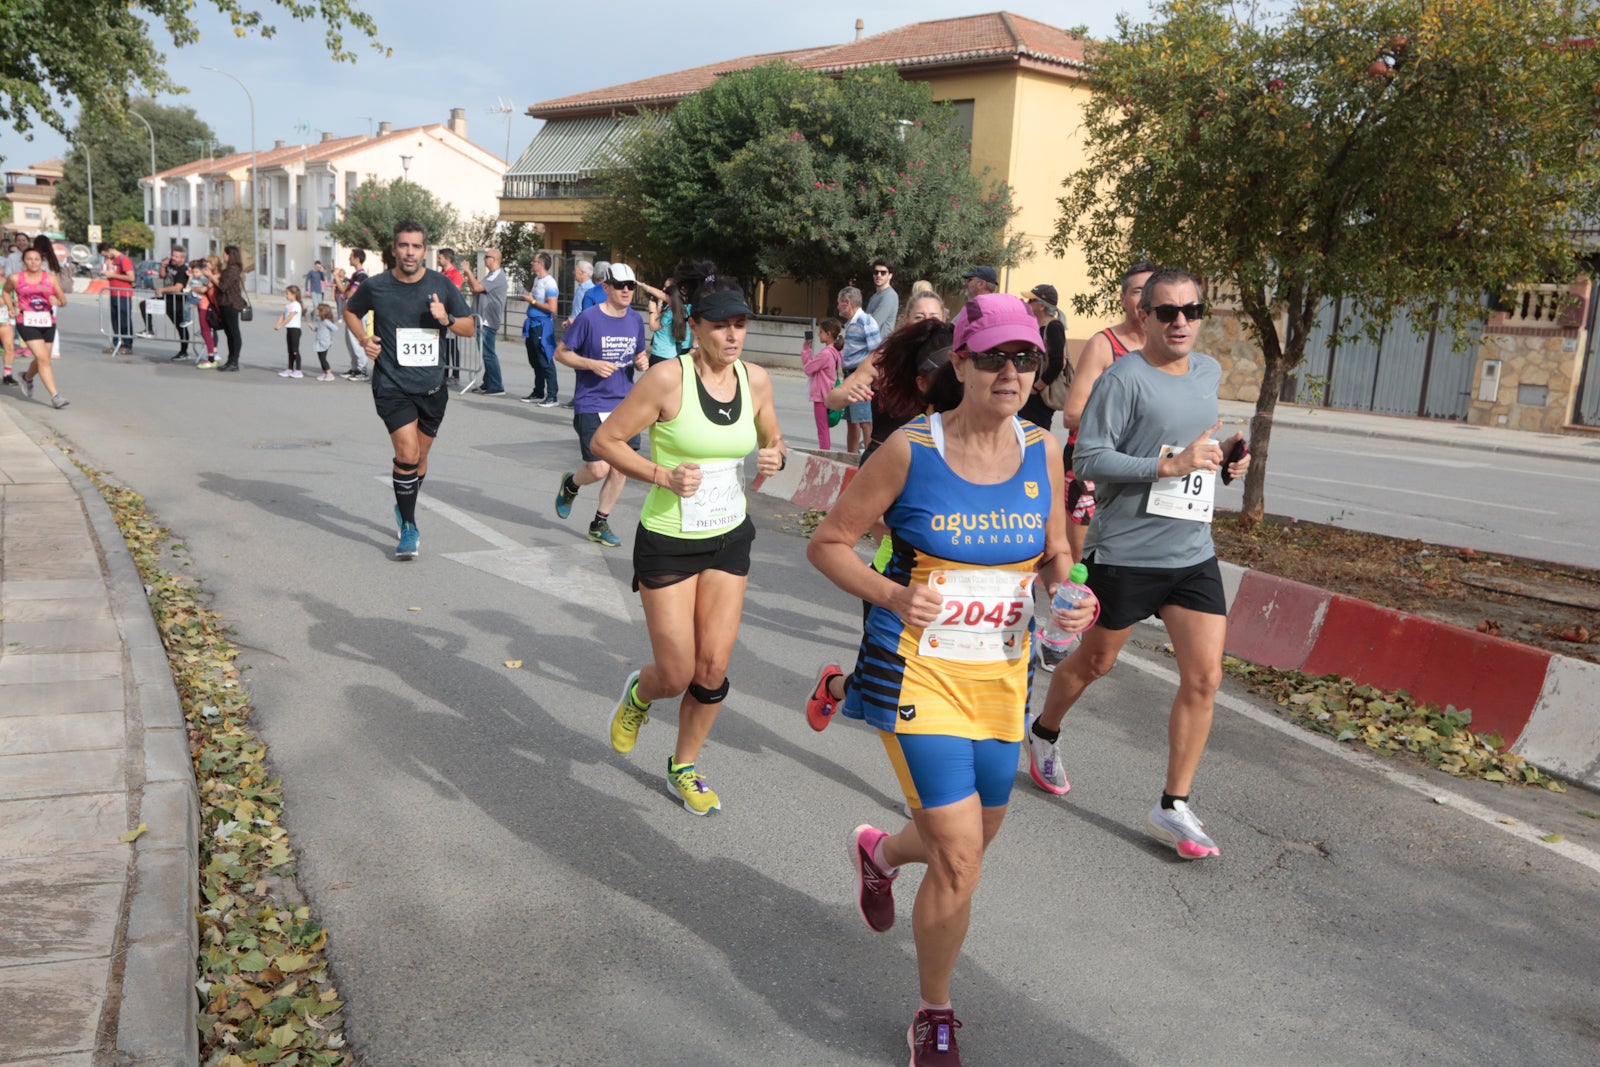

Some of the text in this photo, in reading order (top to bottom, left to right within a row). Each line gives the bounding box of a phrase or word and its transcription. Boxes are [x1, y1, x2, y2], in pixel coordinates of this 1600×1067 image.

[403, 343, 433, 355] 3131
[1181, 474, 1203, 496] 19
[931, 509, 1043, 538] agustinos
[951, 534, 1036, 546] GRANADA
[940, 600, 1024, 628] 2045
